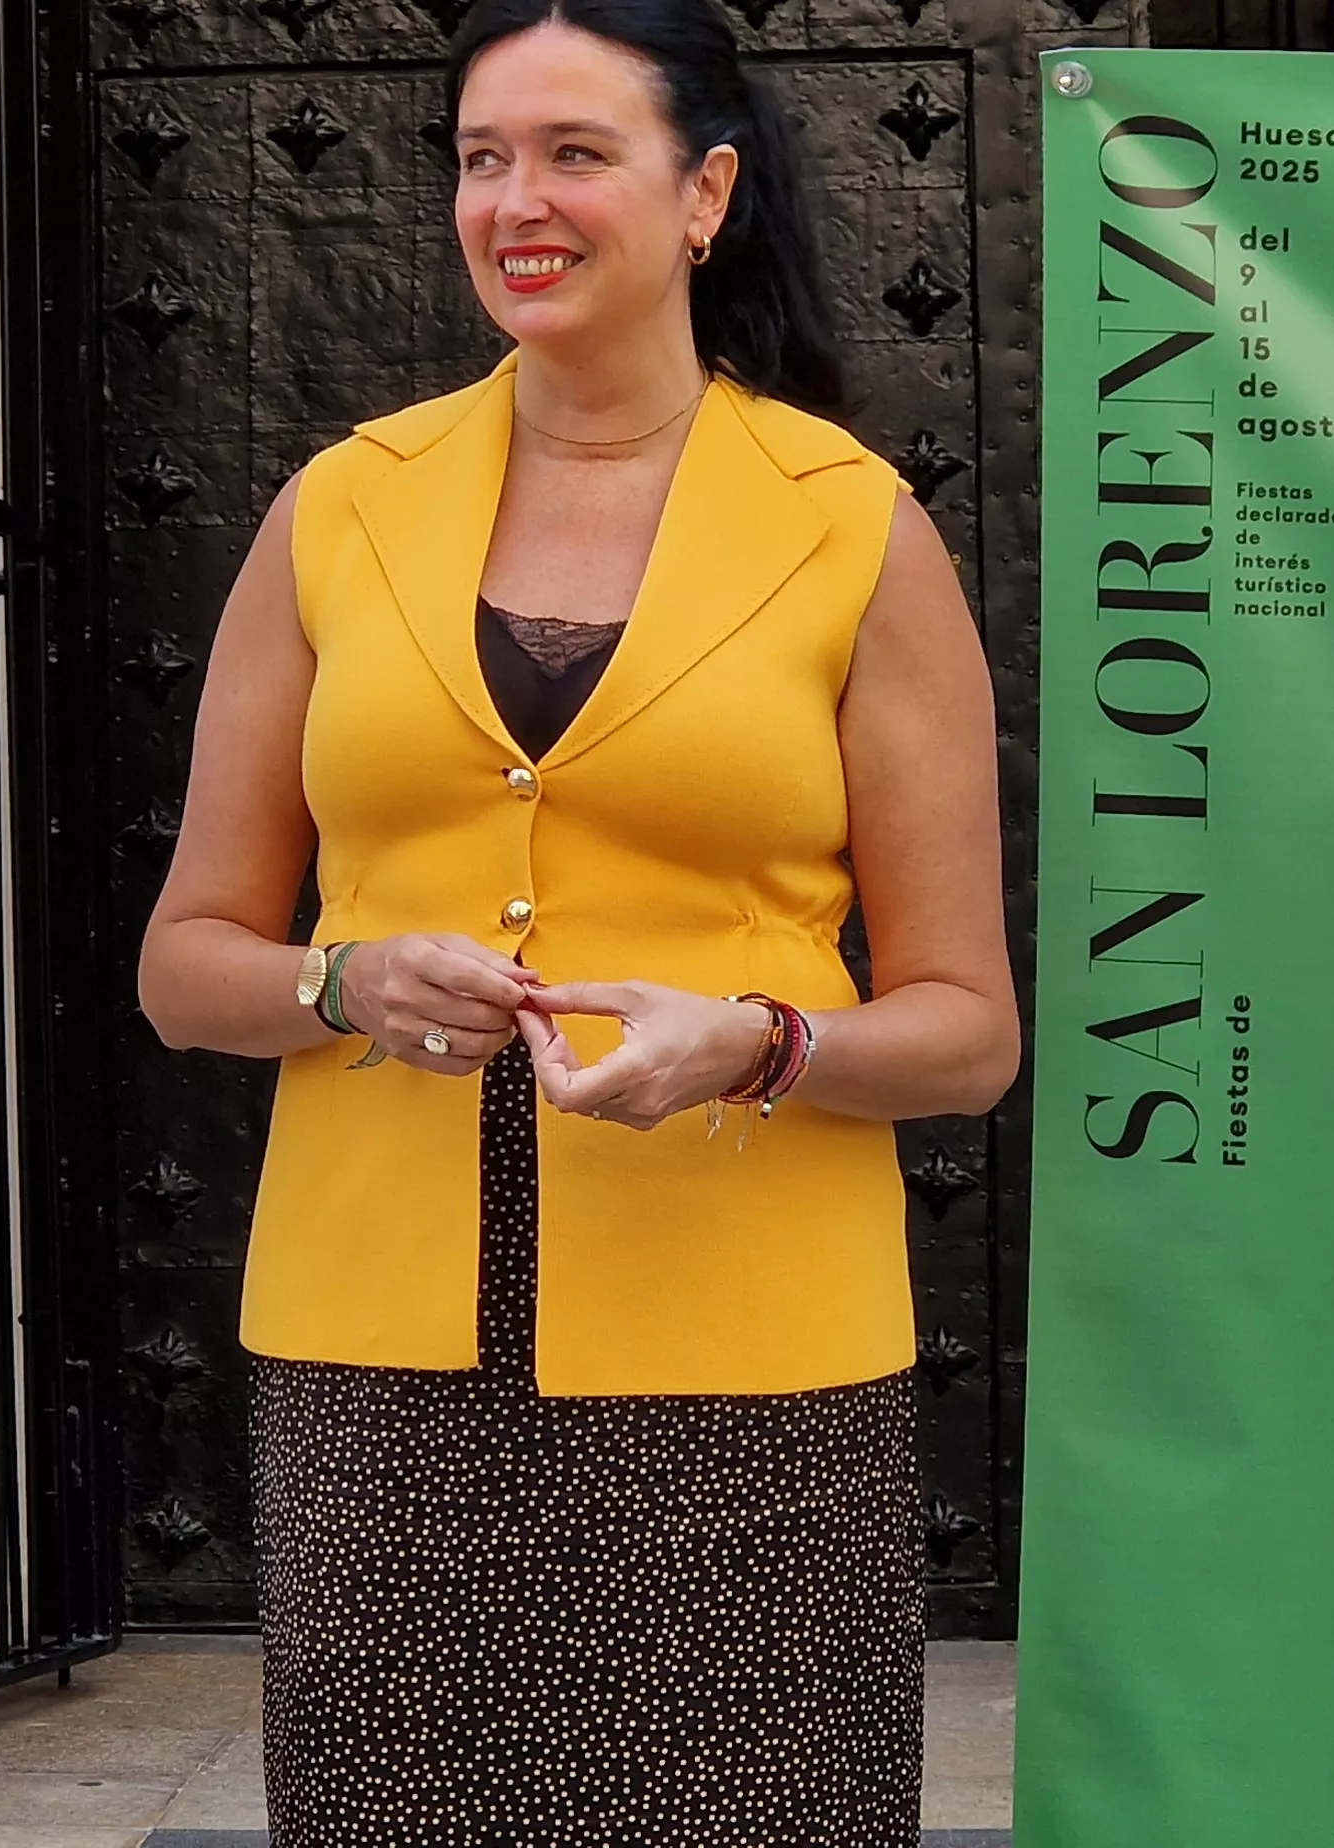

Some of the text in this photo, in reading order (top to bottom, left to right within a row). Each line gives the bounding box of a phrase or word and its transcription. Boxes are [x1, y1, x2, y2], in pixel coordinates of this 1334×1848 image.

[1239, 157, 1320, 184] 2025
[1239, 225, 1290, 253] del
[1239, 263, 1257, 287] 9
[1239, 298, 1268, 324] al
[1238, 336, 1271, 361] 15
[1238, 372, 1278, 399] de
[1236, 481, 1313, 500] Fiestas
[1235, 528, 1261, 545] de
[1234, 551, 1311, 572] interés
[1234, 575, 1327, 595] turístico
[1233, 599, 1326, 619] nacional
[1083, 114, 1219, 1165] SAN LORENZO
[1221, 994, 1251, 1167] Fiestas de
